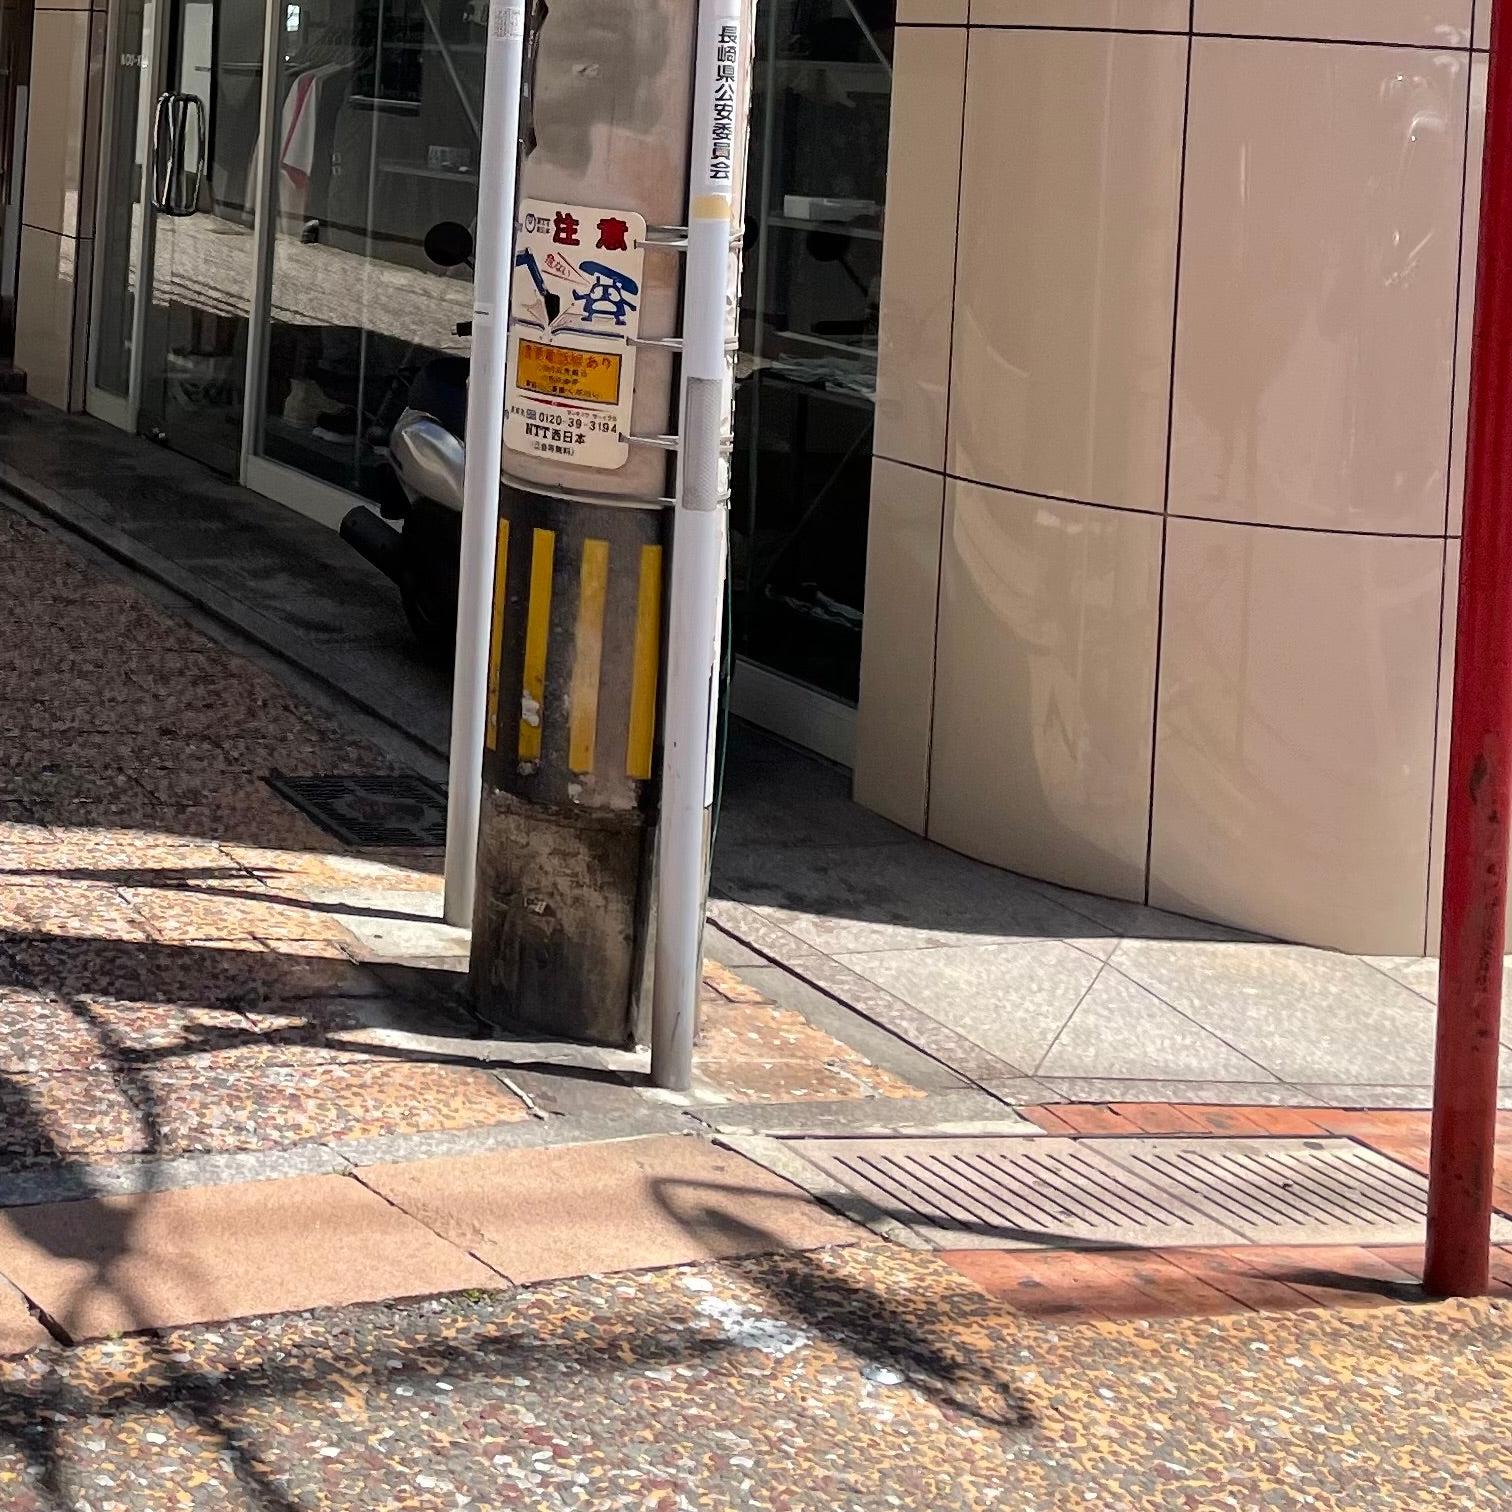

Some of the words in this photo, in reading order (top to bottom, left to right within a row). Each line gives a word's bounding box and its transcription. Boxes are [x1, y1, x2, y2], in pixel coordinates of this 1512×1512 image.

[709, 25, 738, 180] 長崎県公安委員会
[552, 210, 629, 252] 注意
[525, 422, 586, 445] NTT西日本
